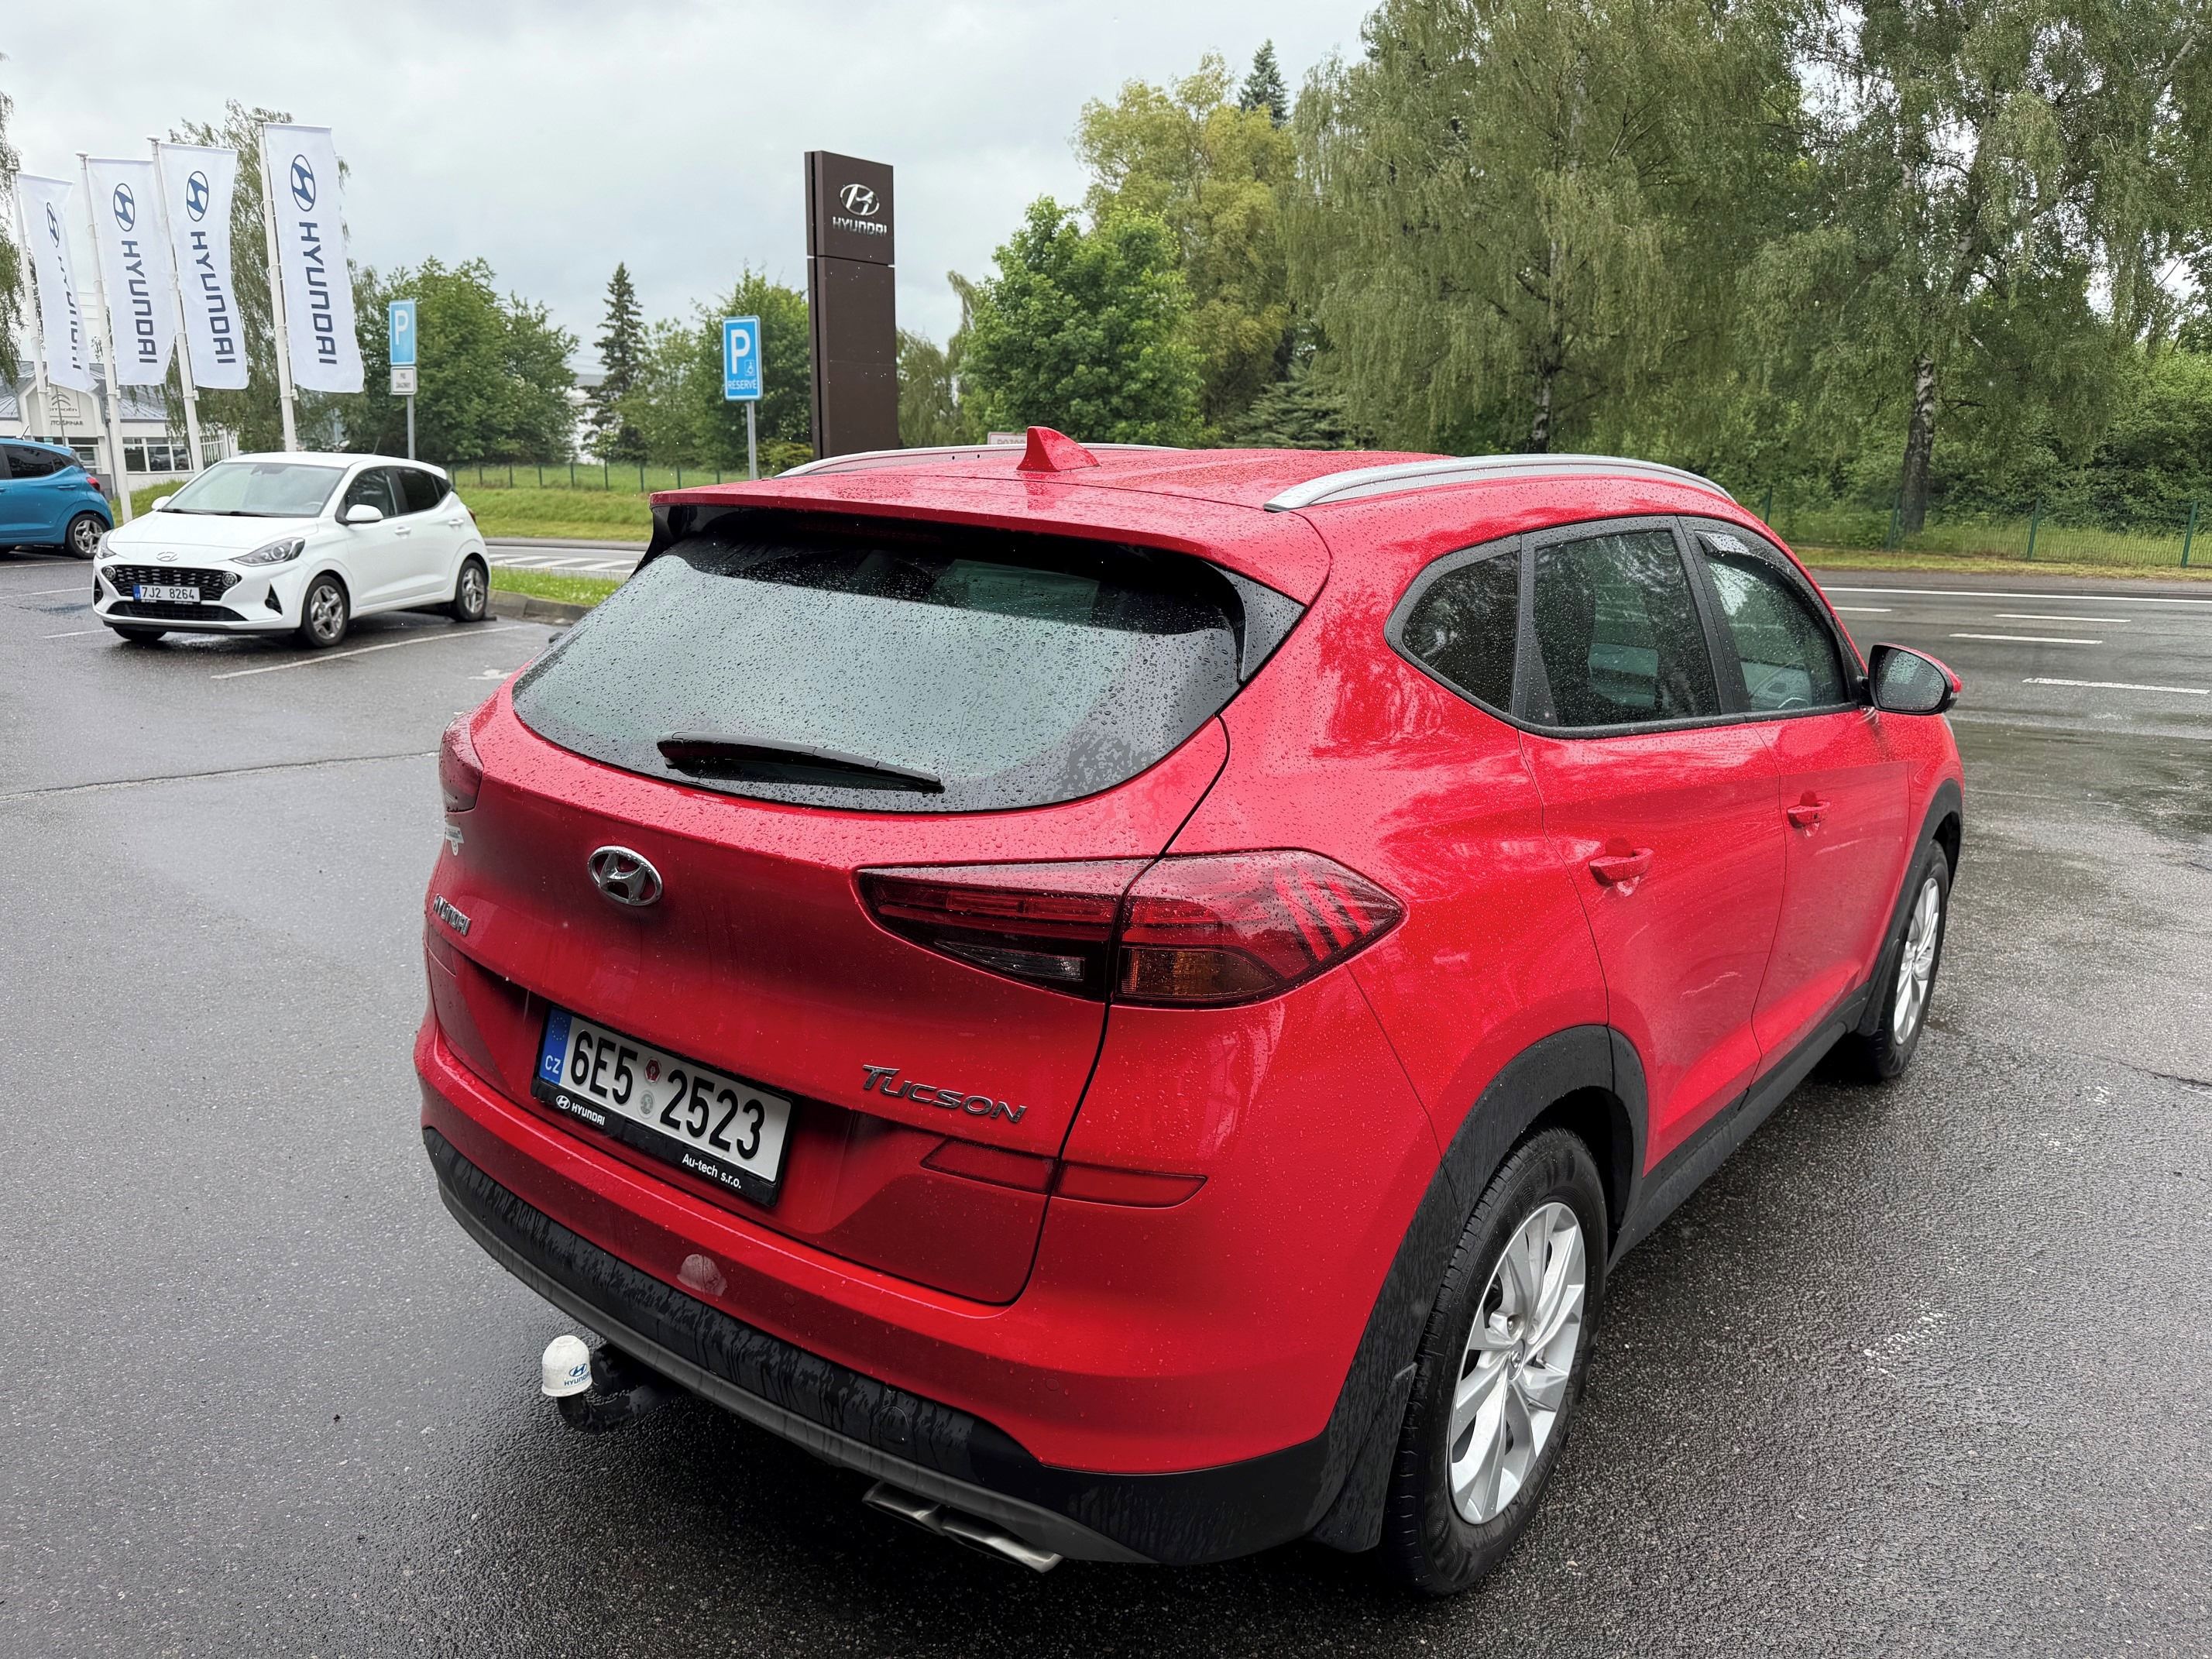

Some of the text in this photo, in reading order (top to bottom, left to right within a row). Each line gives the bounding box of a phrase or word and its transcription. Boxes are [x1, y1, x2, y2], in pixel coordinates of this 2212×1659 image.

[833, 217, 887, 236] HYUNDAI
[121, 240, 158, 363] HYUNDAI
[191, 231, 236, 364] HYUNDAI
[299, 222, 337, 365] HYUNDAI
[394, 310, 409, 345] P
[730, 328, 750, 375] P
[142, 586, 162, 599] 7J2
[169, 588, 194, 600] 8264
[433, 893, 471, 936] HYUNDAI
[544, 1055, 562, 1074] CZ
[570, 1029, 765, 1160] 6E5 2523
[572, 1102, 605, 1126] HYUNDAI
[863, 1064, 1028, 1123] TUCSON
[682, 1152, 742, 1190] Au-tech s.r.o.
